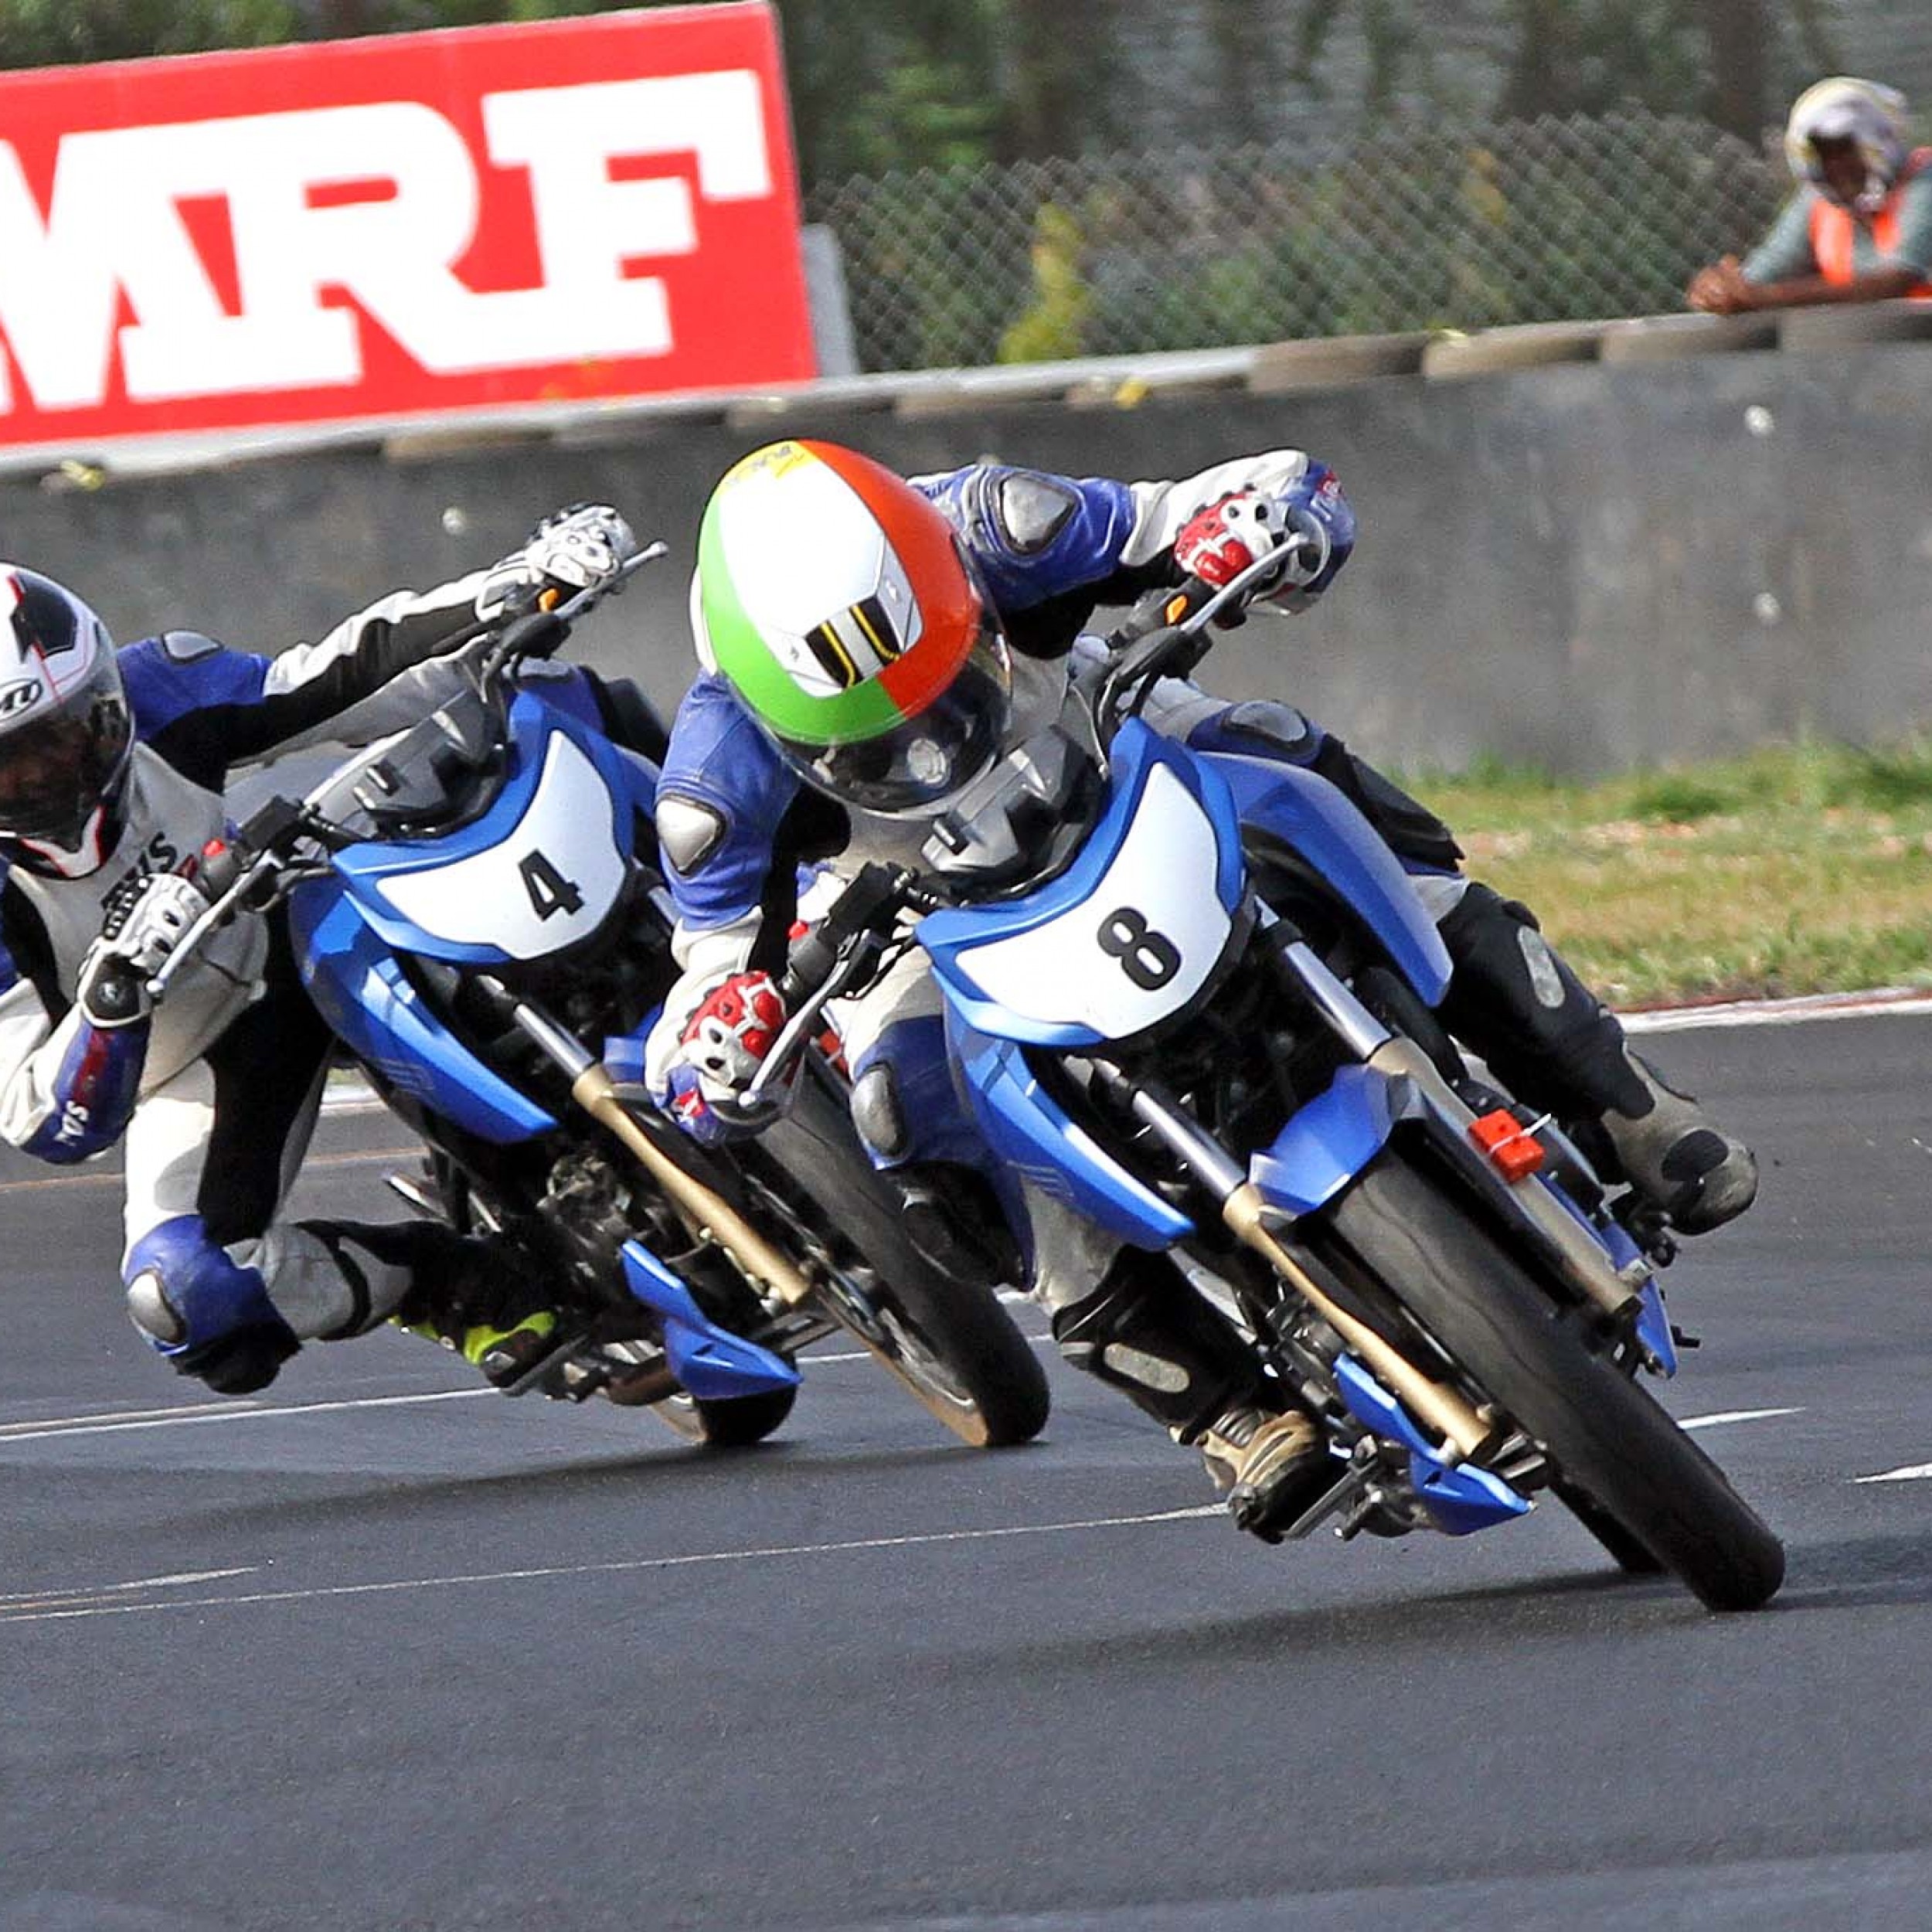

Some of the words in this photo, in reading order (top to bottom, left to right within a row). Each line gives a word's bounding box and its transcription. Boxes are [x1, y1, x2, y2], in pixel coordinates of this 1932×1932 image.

[0, 69, 773, 415] MRF
[519, 848, 585, 921] 4
[1097, 906, 1182, 991] 8
